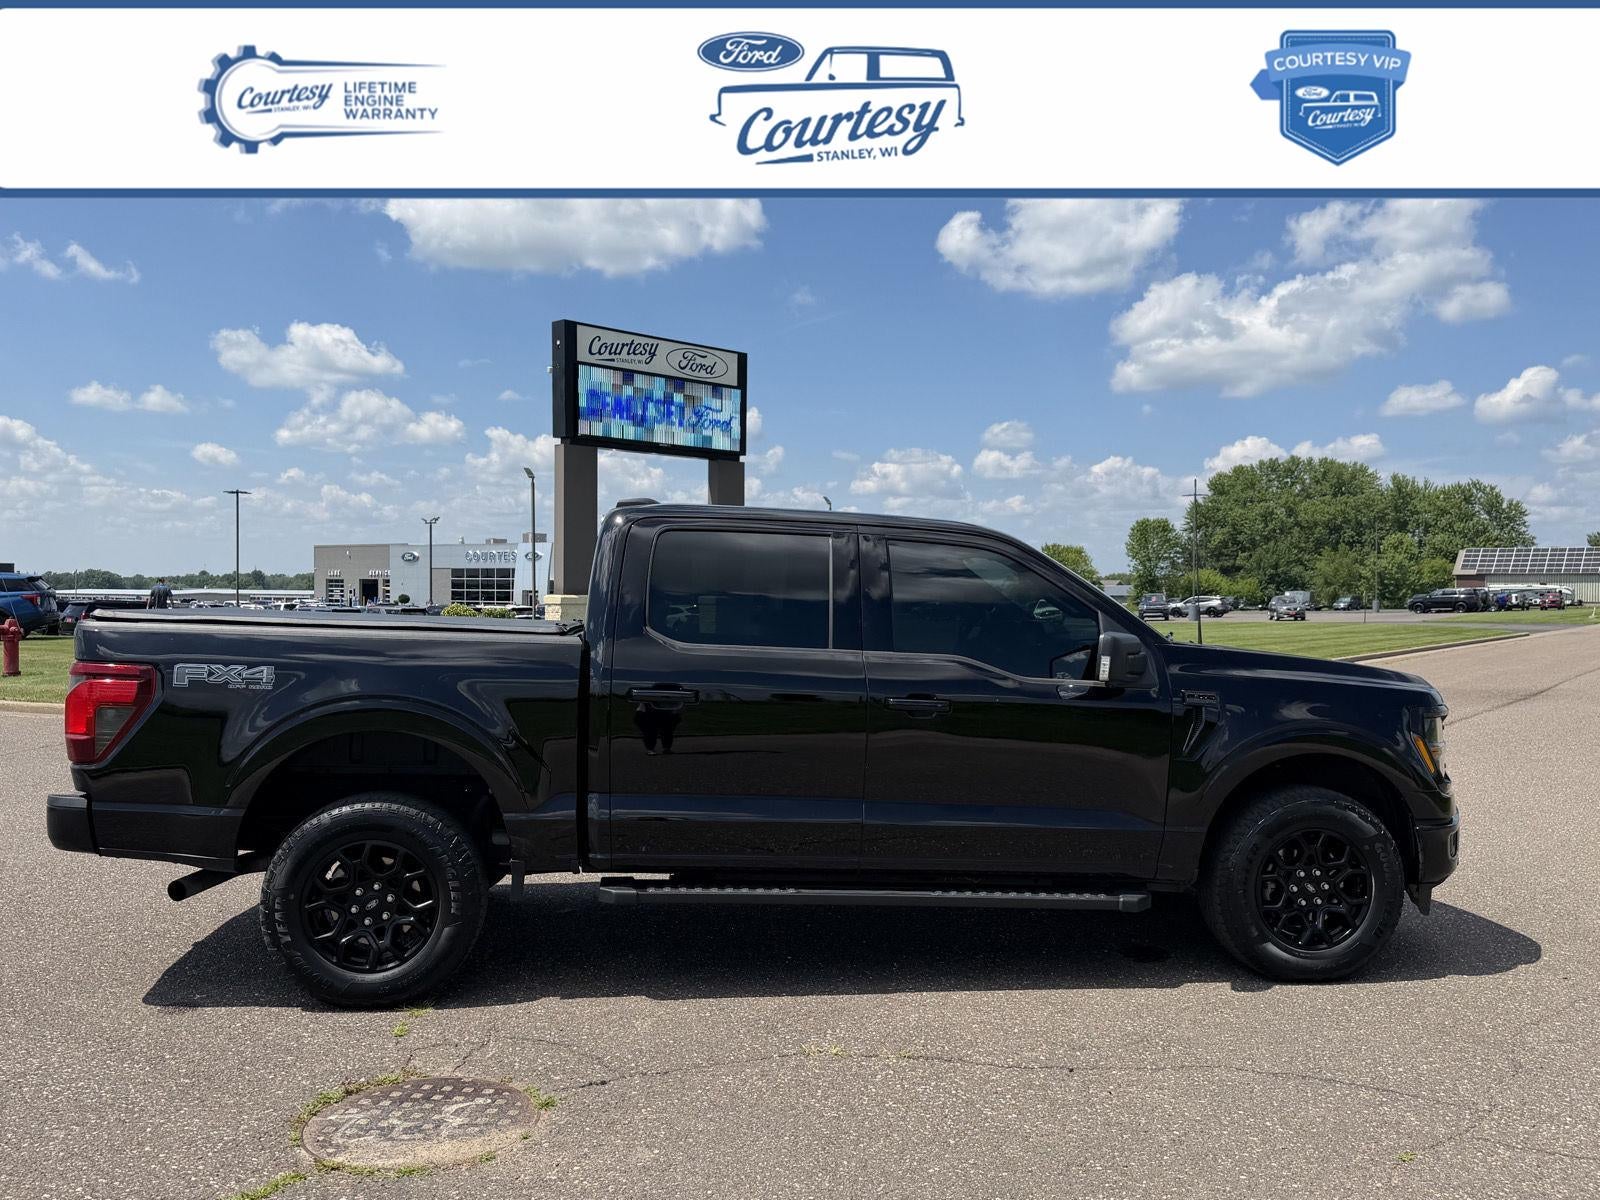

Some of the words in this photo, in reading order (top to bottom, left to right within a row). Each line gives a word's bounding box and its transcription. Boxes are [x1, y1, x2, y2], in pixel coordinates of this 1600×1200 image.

[588, 336, 659, 365] Courtesy
[678, 351, 717, 376] Ford
[173, 663, 275, 687] FX4
